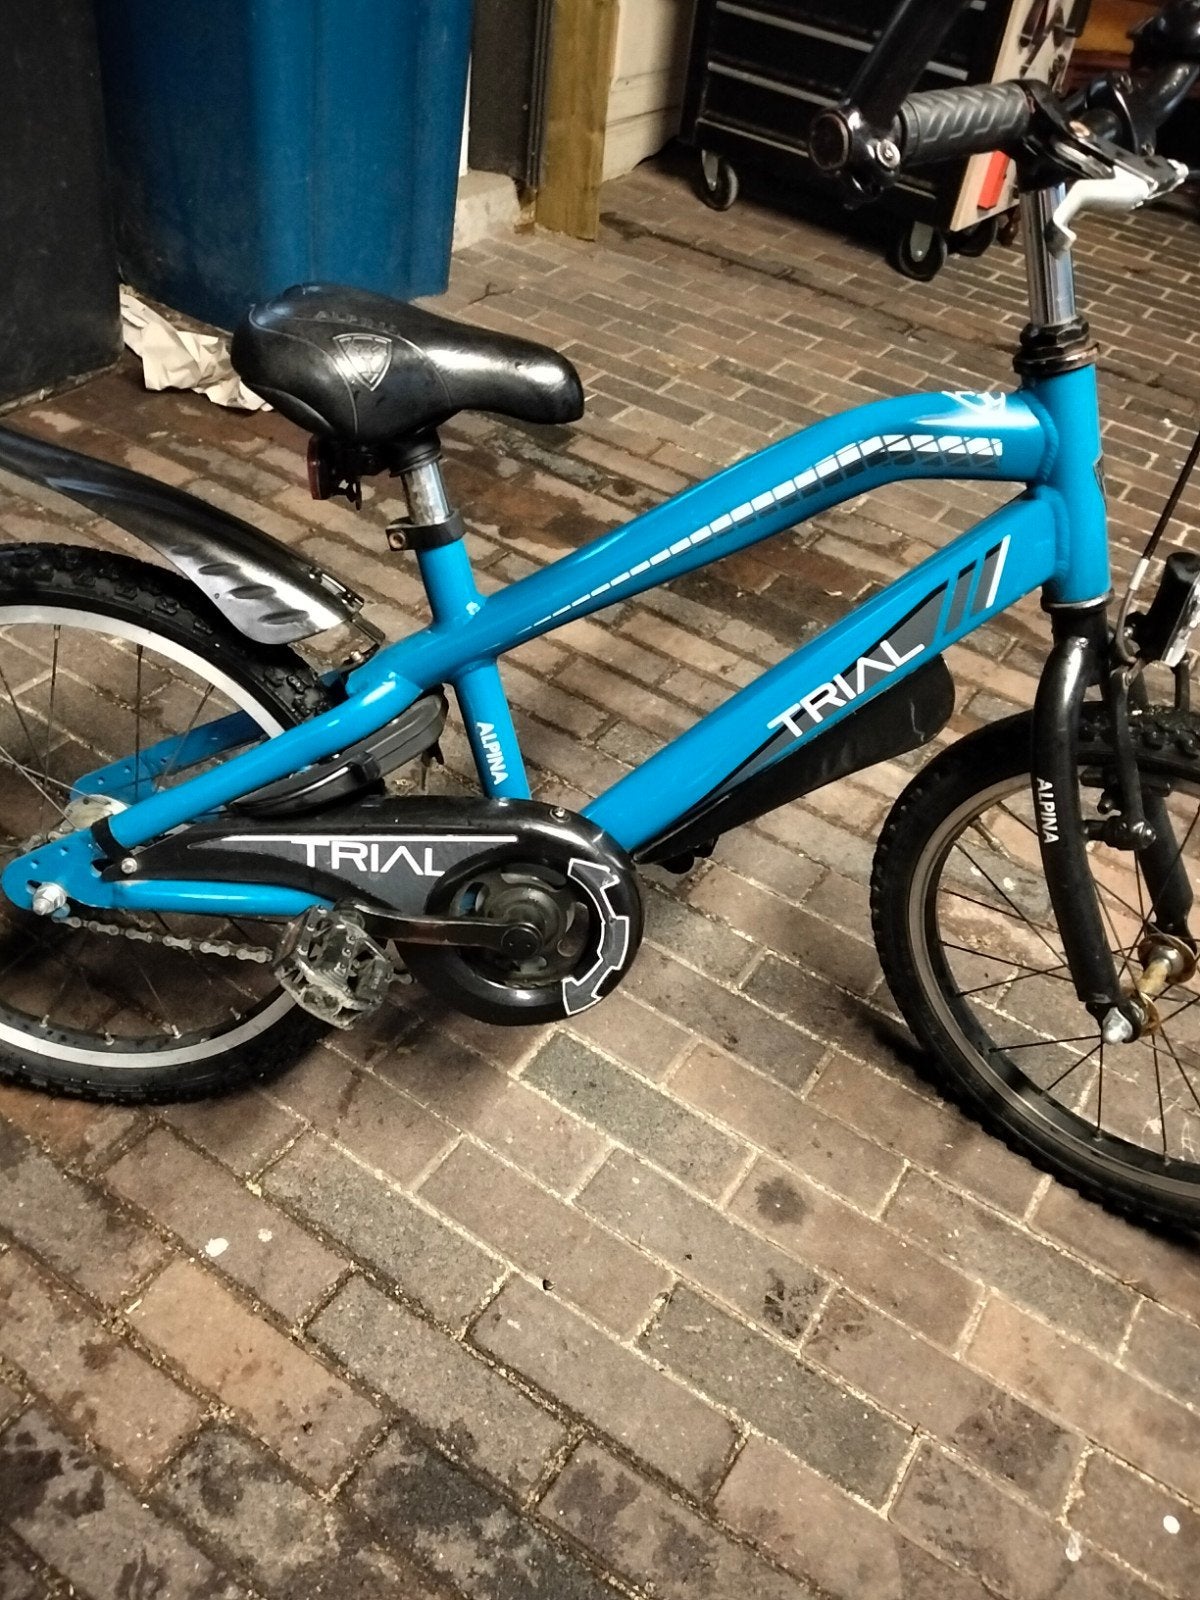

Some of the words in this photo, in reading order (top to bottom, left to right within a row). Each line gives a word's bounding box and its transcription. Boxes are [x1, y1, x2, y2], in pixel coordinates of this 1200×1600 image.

[766, 639, 925, 737] TRIAL
[476, 721, 509, 785] ALPINA
[1036, 776, 1059, 843] ALPINA
[290, 839, 446, 877] TRIAL
